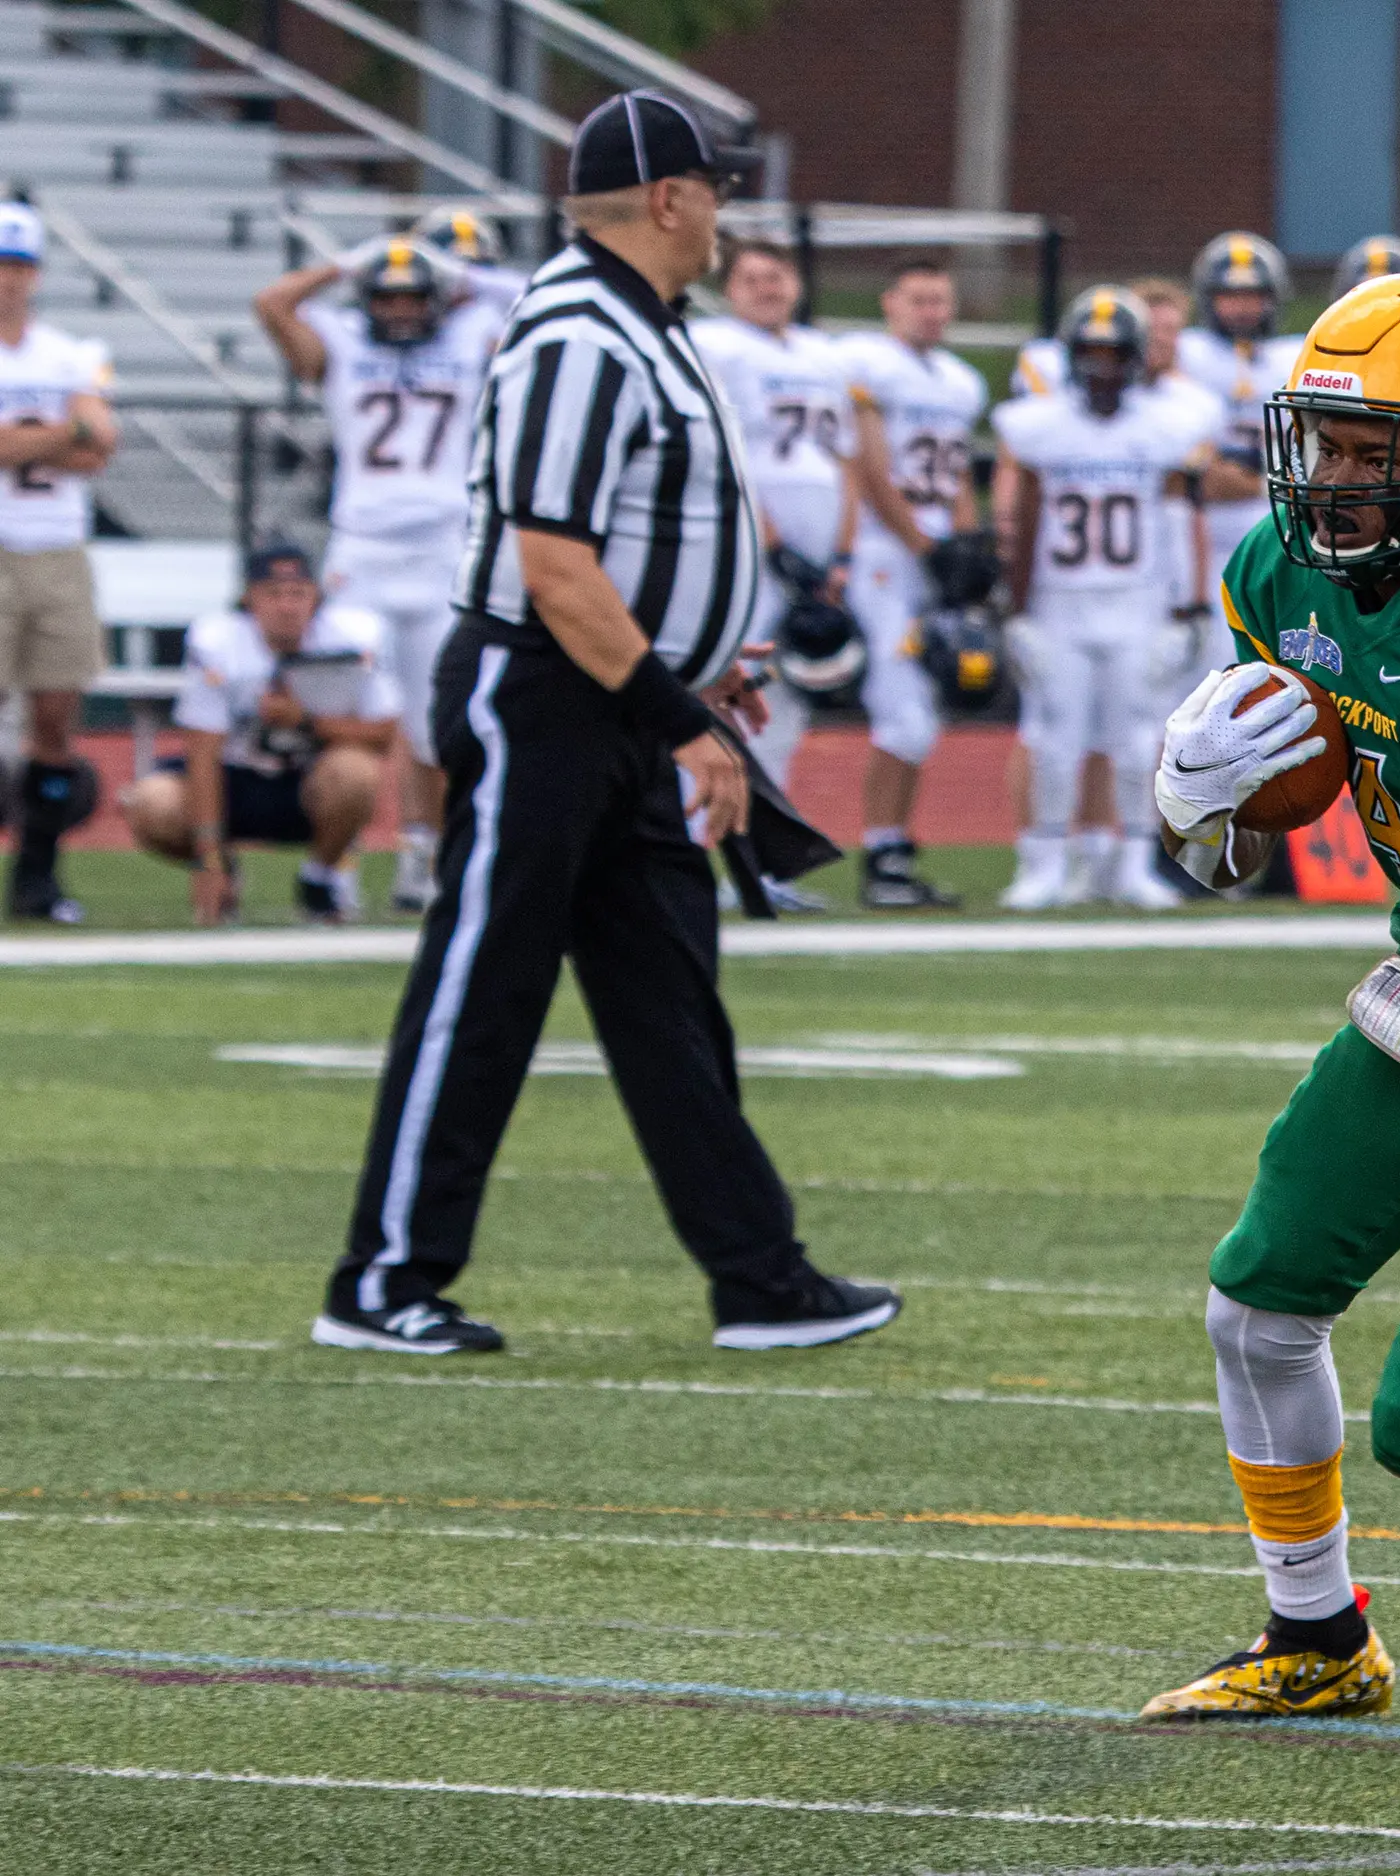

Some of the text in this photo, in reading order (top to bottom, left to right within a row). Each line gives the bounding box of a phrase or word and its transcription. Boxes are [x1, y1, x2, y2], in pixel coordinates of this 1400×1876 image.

[1303, 373, 1353, 390] Riddell
[356, 389, 456, 469] 27
[1053, 493, 1137, 566] 30
